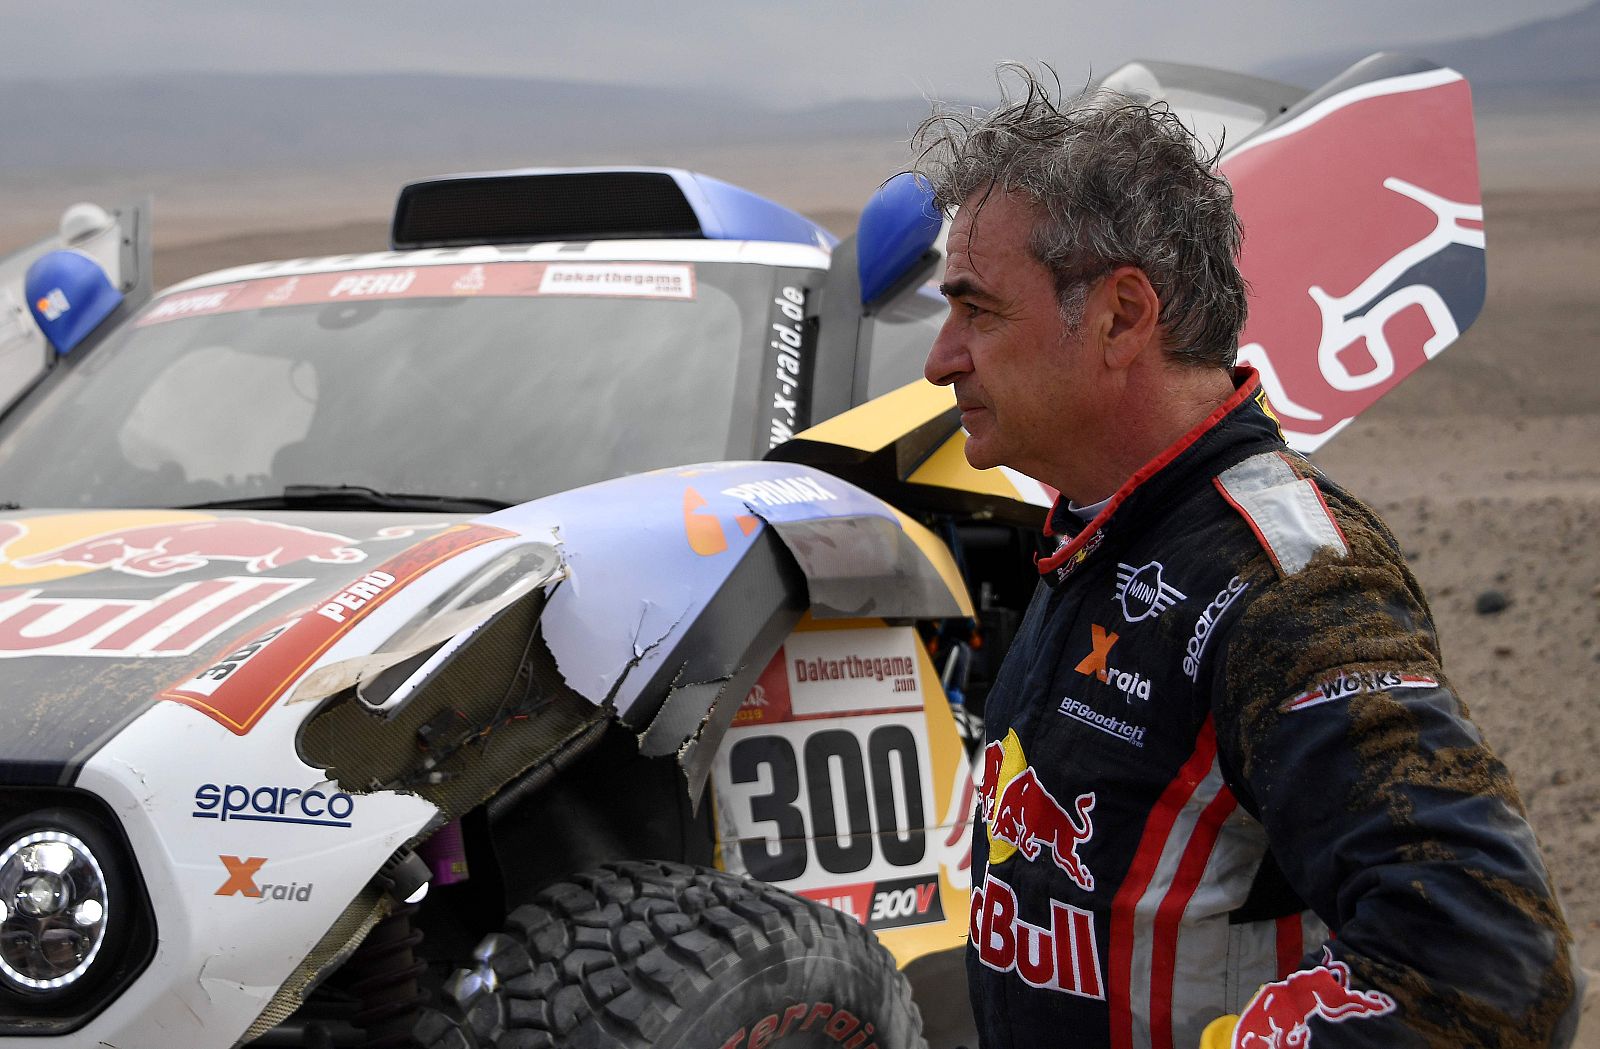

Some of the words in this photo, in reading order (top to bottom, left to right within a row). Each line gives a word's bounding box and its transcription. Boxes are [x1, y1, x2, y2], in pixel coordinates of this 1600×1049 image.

[769, 286, 805, 449] w.x-raid.de
[720, 476, 838, 506] PRIMAX
[1129, 579, 1156, 605] MINI
[0, 577, 316, 657] ull
[1183, 575, 1244, 677] sparco
[794, 655, 914, 682] Dakarthegame
[892, 677, 917, 692] .com
[1319, 671, 1402, 699] WORKS
[193, 783, 354, 823] sparco
[730, 724, 925, 882] 300
[870, 882, 937, 921] 300V
